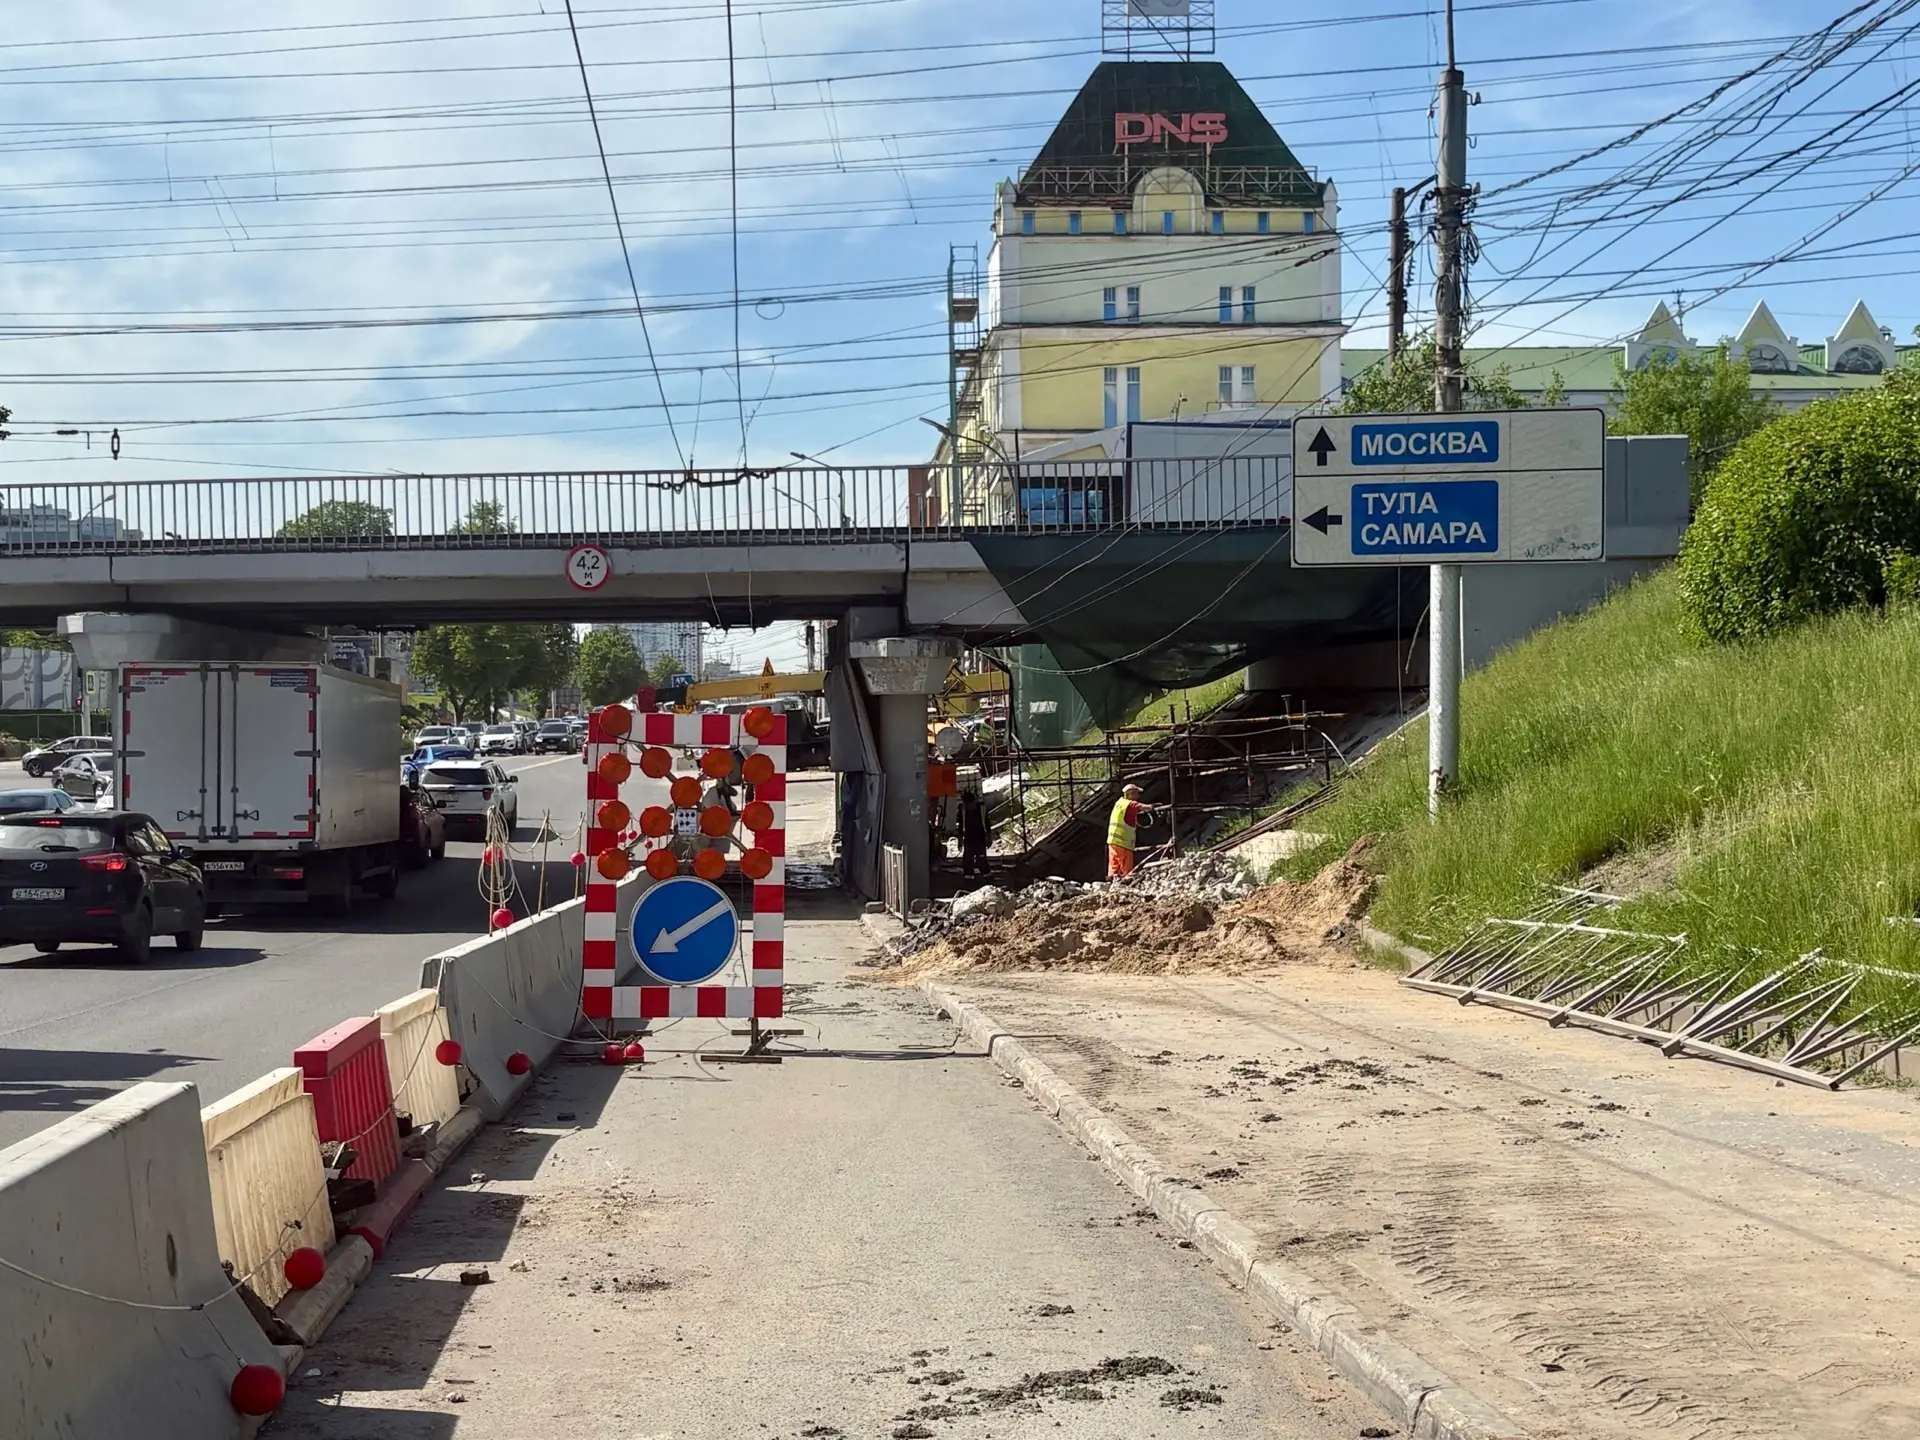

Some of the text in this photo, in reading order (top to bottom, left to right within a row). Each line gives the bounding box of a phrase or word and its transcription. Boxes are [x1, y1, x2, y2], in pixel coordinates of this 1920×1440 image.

[1115, 112, 1228, 144] DNS
[1361, 431, 1488, 457] МОСКВА
[1361, 492, 1439, 516] ТУЛА
[1361, 521, 1487, 546] САМАРА
[576, 555, 600, 571] 4,2
